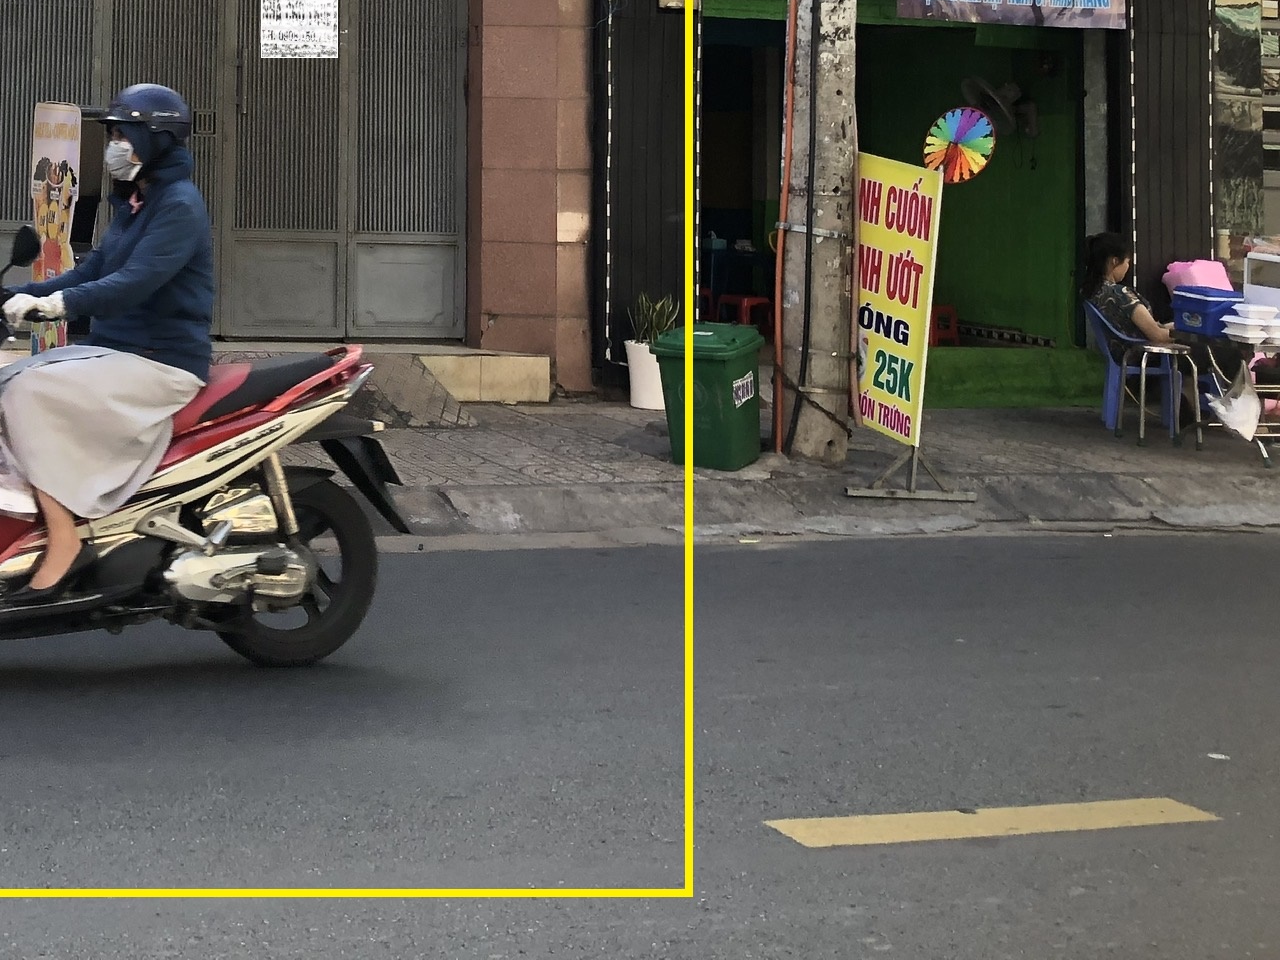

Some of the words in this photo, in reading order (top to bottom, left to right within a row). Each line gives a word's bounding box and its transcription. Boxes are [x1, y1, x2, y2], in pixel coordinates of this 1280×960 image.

[859, 178, 883, 224] NH
[884, 178, 933, 241] CUỐN
[859, 243, 883, 294] NH
[886, 250, 923, 309] ƯỚT
[859, 302, 909, 346] ÓNG
[873, 348, 915, 402] 25K
[878, 399, 911, 438] TRỨNG
